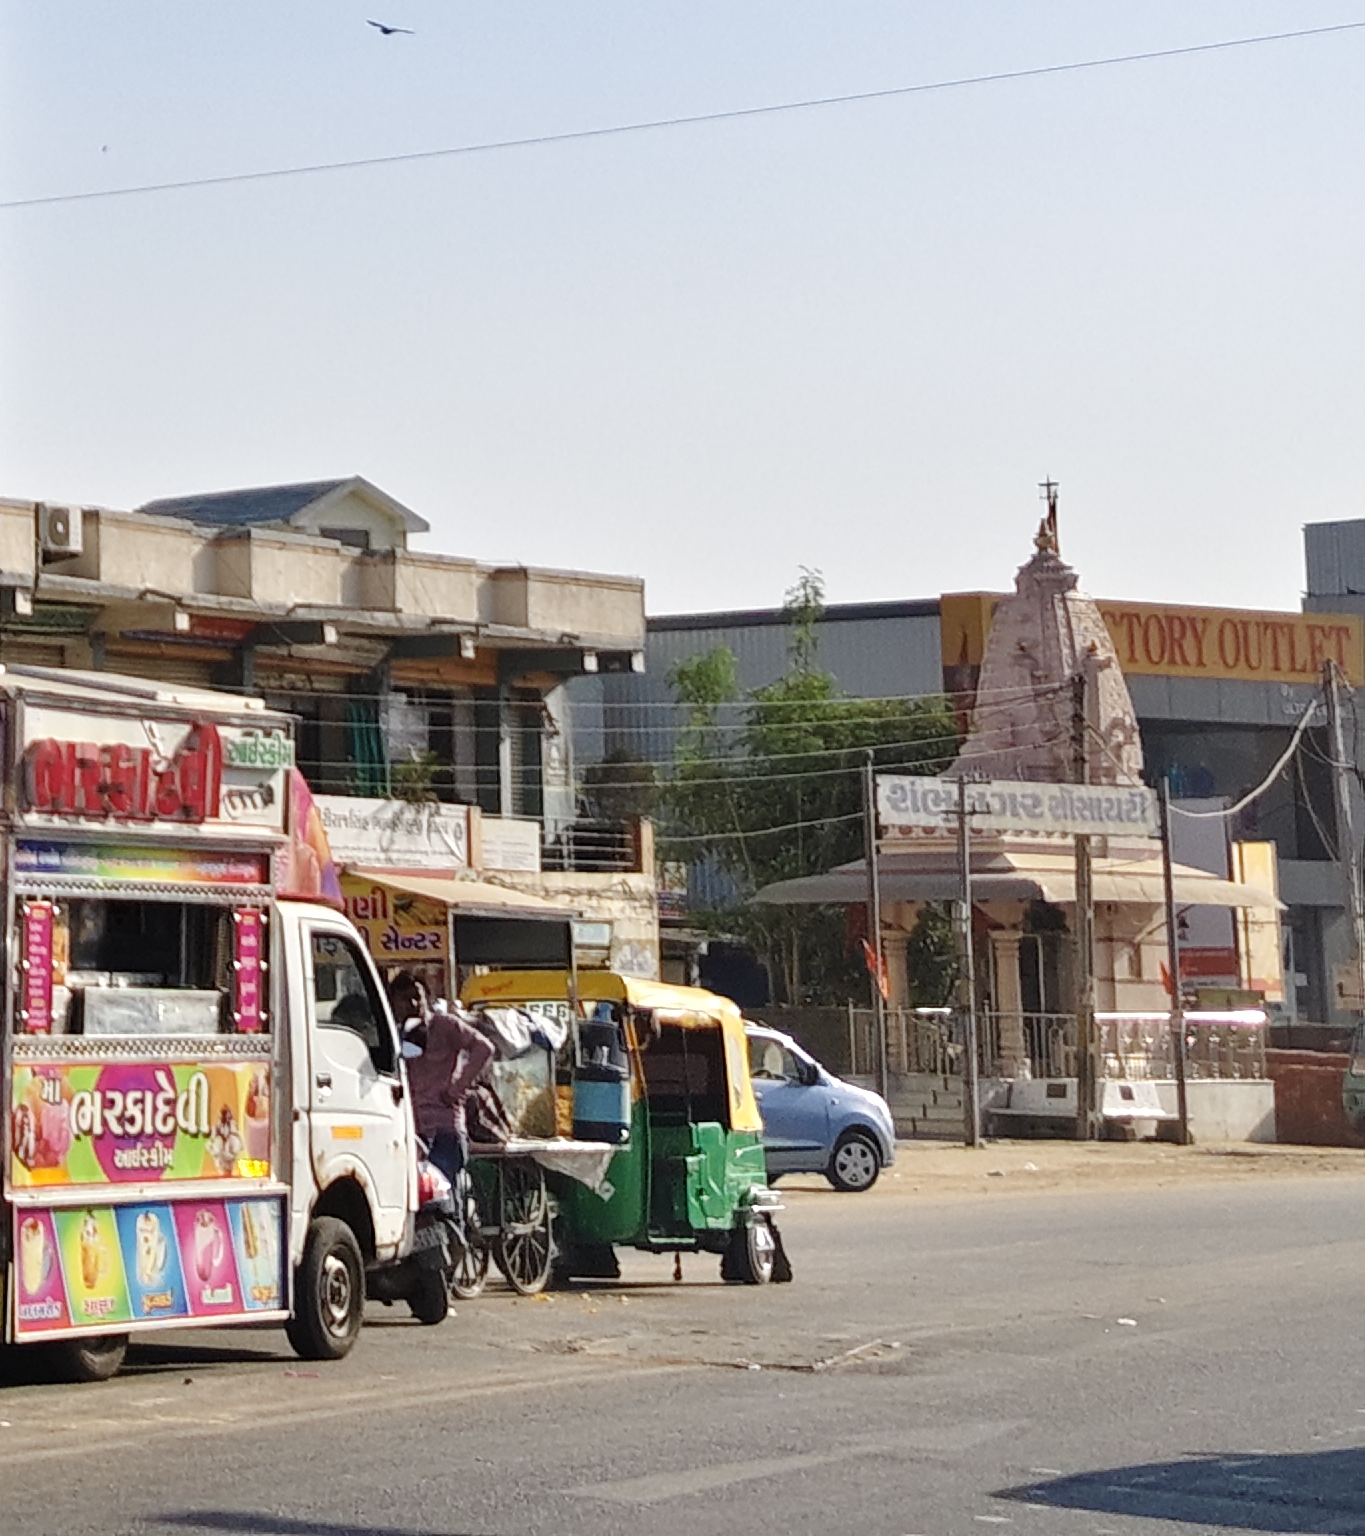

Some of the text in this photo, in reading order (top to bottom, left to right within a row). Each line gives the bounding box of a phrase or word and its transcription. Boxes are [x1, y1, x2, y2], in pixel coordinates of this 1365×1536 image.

[1218, 617, 1352, 674] OUTLET
[380, 925, 443, 951] સેન્ટર
[70, 1069, 210, 1137] ભરકાદેવી
